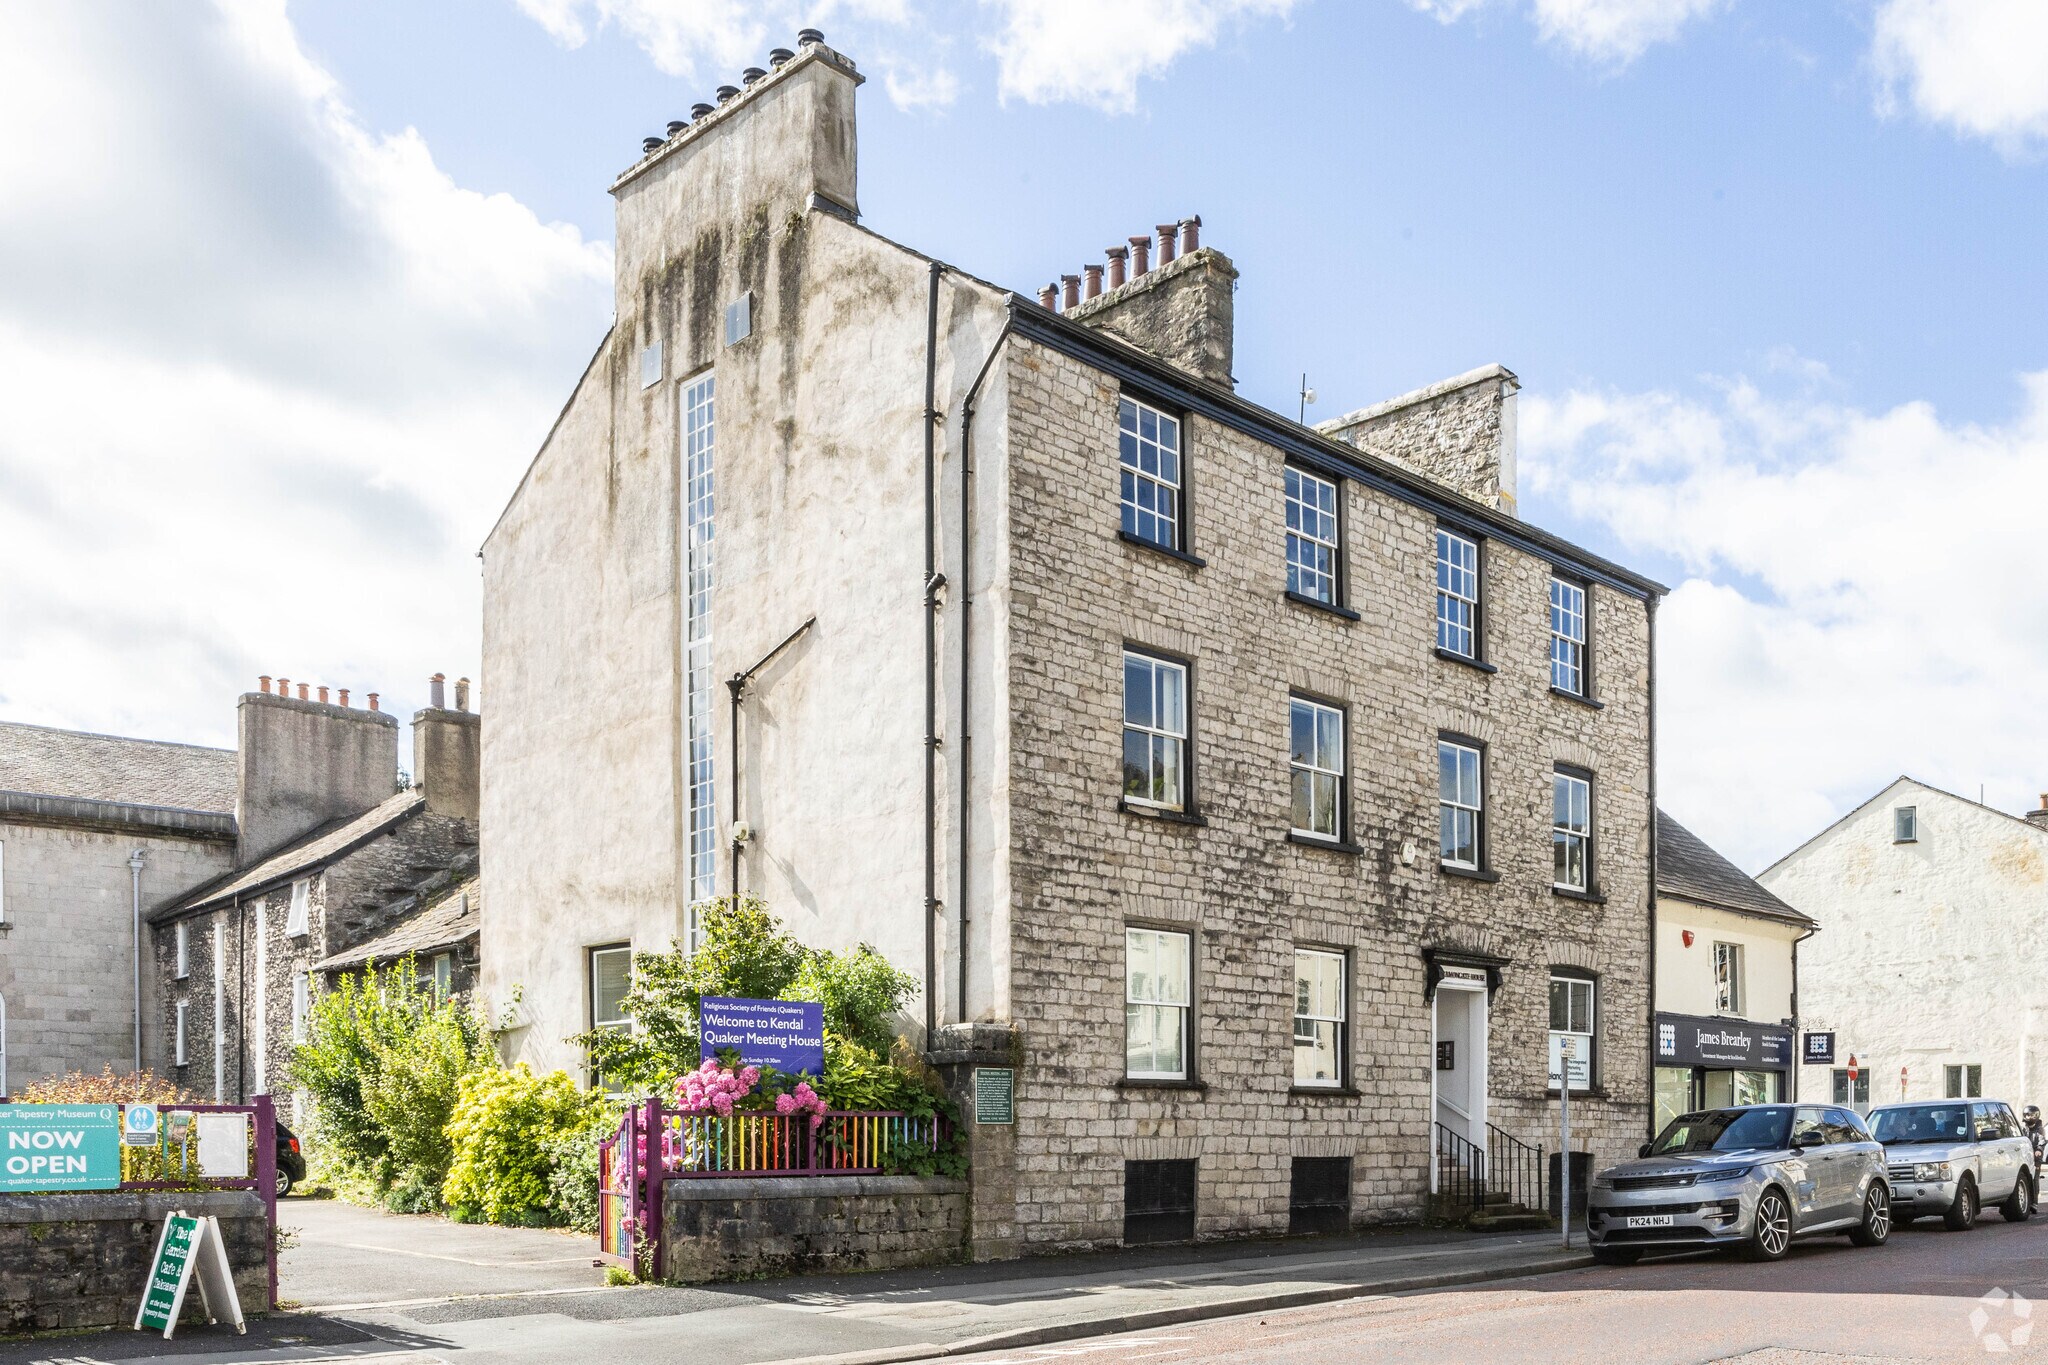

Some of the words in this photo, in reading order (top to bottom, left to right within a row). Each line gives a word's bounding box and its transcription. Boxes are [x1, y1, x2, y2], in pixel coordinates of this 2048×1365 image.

[704, 1002, 729, 1011] Religious
[730, 1003, 749, 1012] Society
[757, 1004, 776, 1012] Friends
[778, 1006, 804, 1015] (Quakers)
[704, 1014, 754, 1028] Welcome
[756, 1019, 768, 1028] to
[770, 1017, 804, 1030] Kendal
[704, 1030, 744, 1044] Quaker
[746, 1032, 787, 1048] Meeting
[789, 1035, 820, 1046] House
[1696, 1028, 1720, 1048] James
[1721, 1031, 1751, 1051] Brearley
[14, 1110, 54, 1120] Tapestry
[57, 1110, 96, 1118] Museum
[100, 1108, 113, 1124] Q
[9, 1131, 85, 1149] NOW
[6, 1156, 87, 1174] OPEN
[8, 1176, 87, 1185] quaker-tapestry.co.uk
[1630, 1218, 1650, 1226] PK24
[1653, 1217, 1670, 1225] NHJ
[176, 1226, 188, 1240] The
[165, 1243, 187, 1259] Garden
[160, 1261, 175, 1276] Cafe
[176, 1264, 182, 1277] &
[159, 1301, 172, 1310] Quaker
